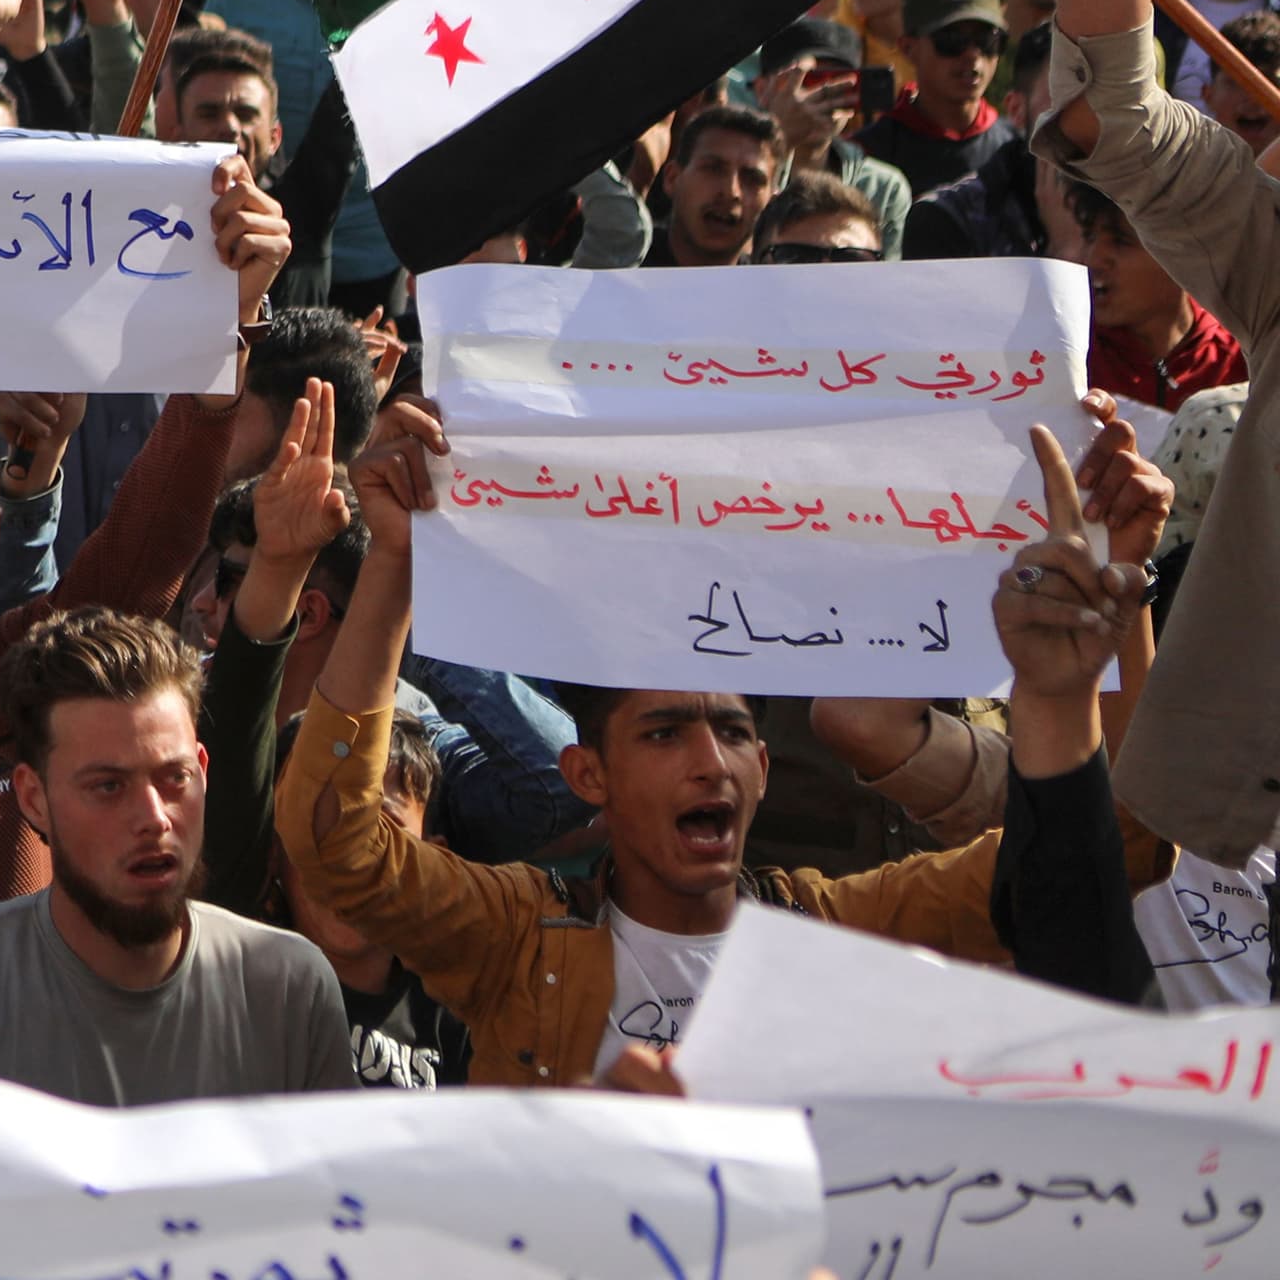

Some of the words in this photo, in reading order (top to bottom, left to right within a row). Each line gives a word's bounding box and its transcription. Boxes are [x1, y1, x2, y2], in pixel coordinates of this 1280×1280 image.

[116, 207, 195, 280] مع
[819, 349, 886, 392] كل
[896, 349, 1046, 402] ثورتي
[697, 483, 829, 532] يرخص
[688, 582, 843, 656] نصالح
[1213, 882, 1252, 898] Baron
[659, 995, 694, 1008] aron
[926, 1171, 1136, 1270] مجرم
